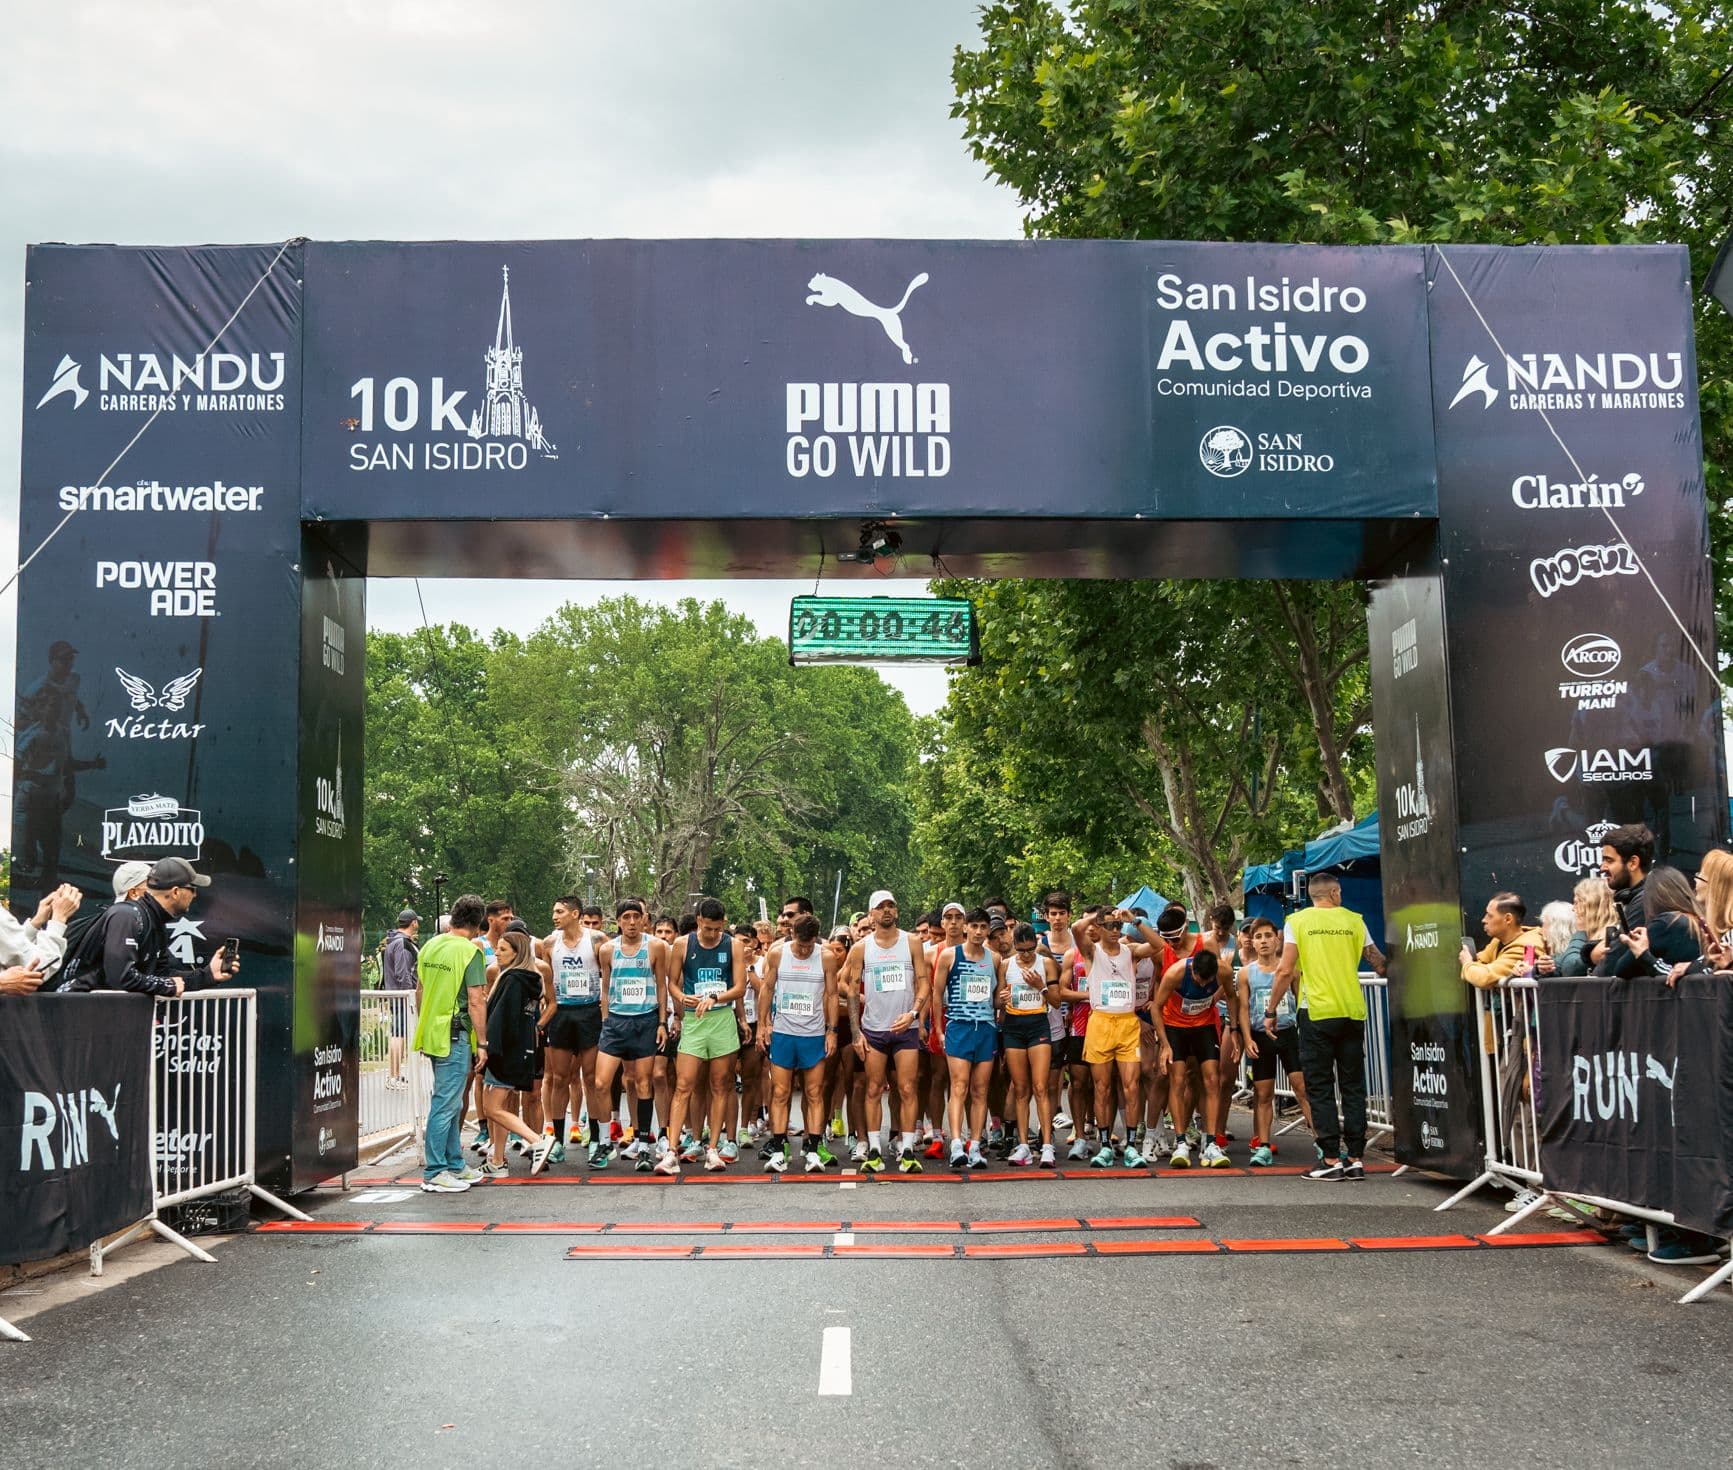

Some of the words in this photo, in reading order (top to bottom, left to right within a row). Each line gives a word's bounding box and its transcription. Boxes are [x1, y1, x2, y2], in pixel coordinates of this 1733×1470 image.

[1156, 273, 1236, 311] San
[1248, 276, 1367, 313] Isidro
[1157, 320, 1370, 373] Activo
[101, 394, 177, 411] CARRERAS
[183, 395, 191, 410] Y
[197, 394, 284, 411] MARATONES
[1157, 378, 1270, 398] Comunidad
[1278, 380, 1372, 401] Deportiva
[1509, 393, 1582, 409] CARRERAS
[1587, 394, 1596, 408] Y
[1601, 393, 1685, 409] MARATONES
[350, 377, 468, 432] 10k
[786, 382, 951, 433] PUMA
[1257, 432, 1303, 451] SAN
[350, 443, 414, 470] SAN
[425, 442, 528, 470] ISIDRO
[787, 435, 836, 478] GO
[848, 435, 951, 477] WILD
[1258, 454, 1334, 472] ISIDRO
[58, 481, 263, 512] smartwater
[1511, 473, 1625, 509] Clarín
[96, 561, 217, 589] POWER
[1529, 543, 1640, 598] MOGUL
[150, 589, 215, 617] ADE
[1565, 647, 1619, 664] ARCOR
[1558, 679, 1628, 699] TURRÓN
[1577, 693, 1617, 711] MANÍ
[104, 714, 206, 740] Néctar
[1581, 748, 1652, 772] IAM
[1582, 770, 1654, 782] SEGUROS
[1395, 783, 1417, 819] 10k
[101, 821, 205, 857] PLAYADITO
[882, 973, 904, 984] A0012
[967, 985, 989, 995] A0042
[622, 987, 644, 997] A0037
[789, 1001, 811, 1012] A0038
[168, 1055, 221, 1074] Salud
[314, 1046, 325, 1067] San
[325, 1043, 343, 1065] Isidro
[1410, 1041, 1423, 1061] San
[1423, 1041, 1446, 1063] Isidro
[313, 1067, 342, 1101] Activo
[1412, 1065, 1448, 1096] Activo
[1572, 1050, 1640, 1123] RUN
[20, 1090, 89, 1171] RUN
